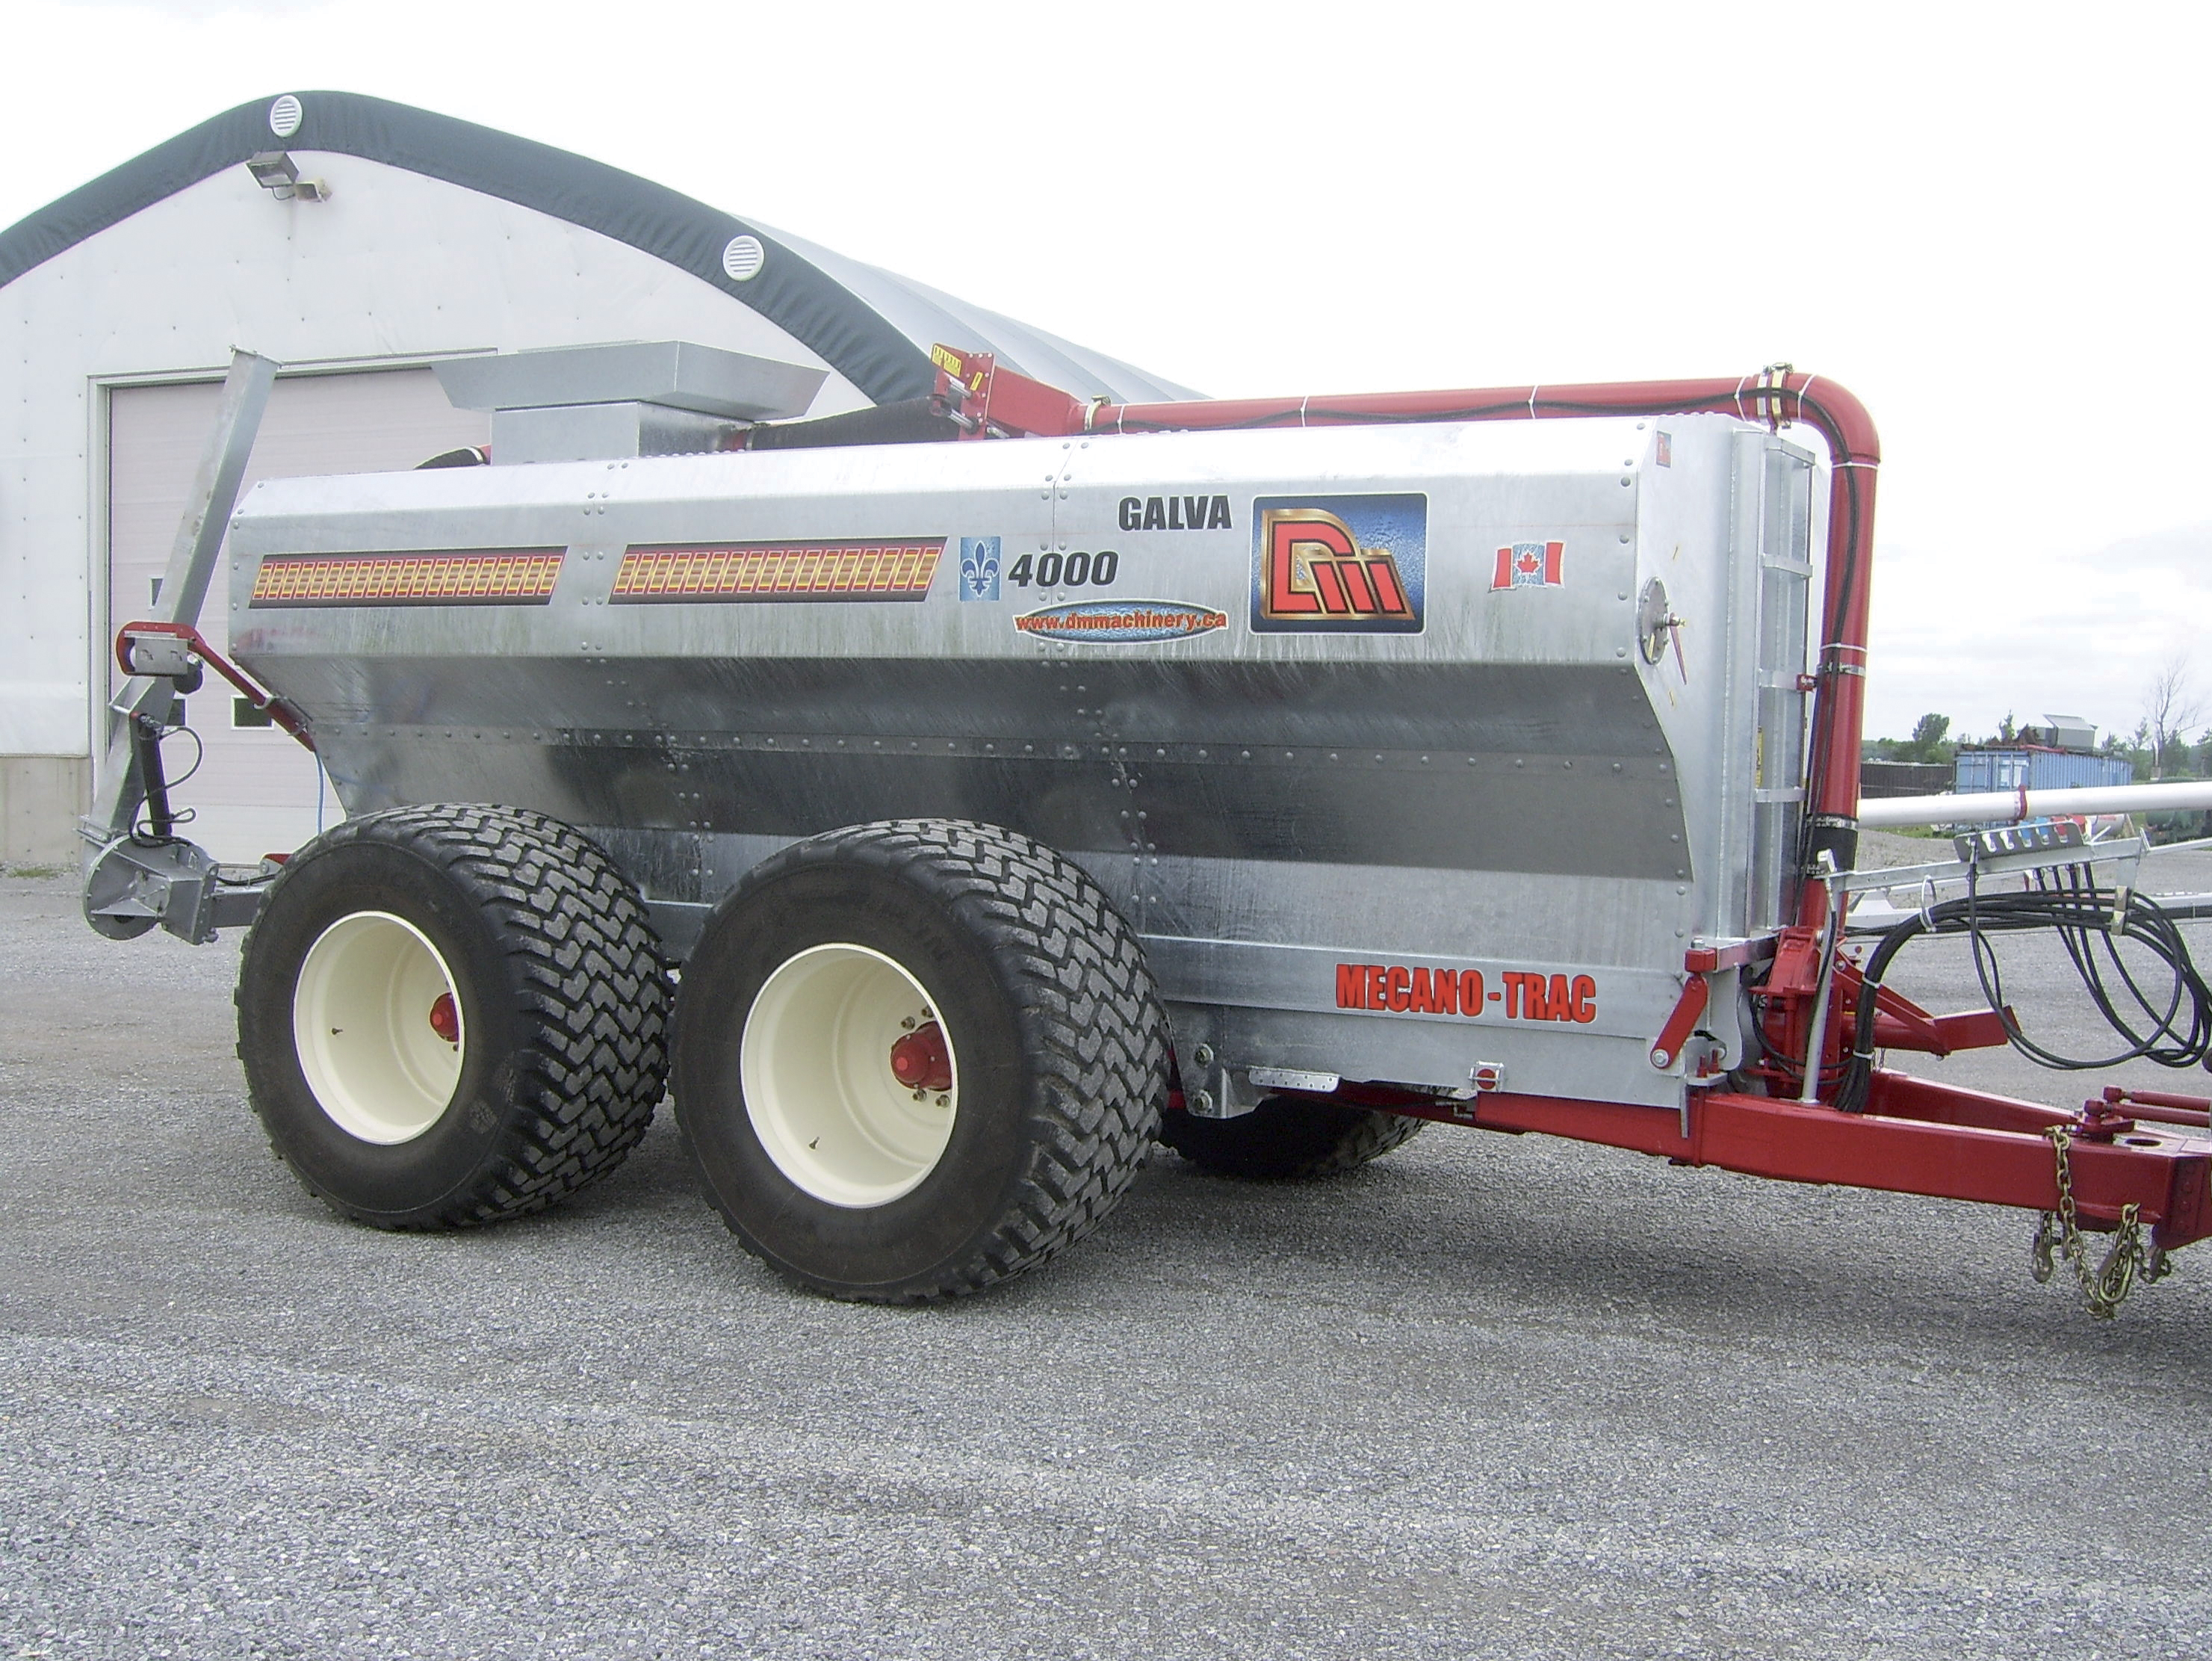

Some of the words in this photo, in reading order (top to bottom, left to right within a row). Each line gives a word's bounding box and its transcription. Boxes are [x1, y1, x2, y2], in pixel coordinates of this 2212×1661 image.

[1119, 495, 1232, 531] GALVA
[1008, 551, 1119, 587] 4000
[1014, 610, 1227, 631] www.dmmachinery.ca
[1335, 963, 1597, 1024] MECANO-TRAC
